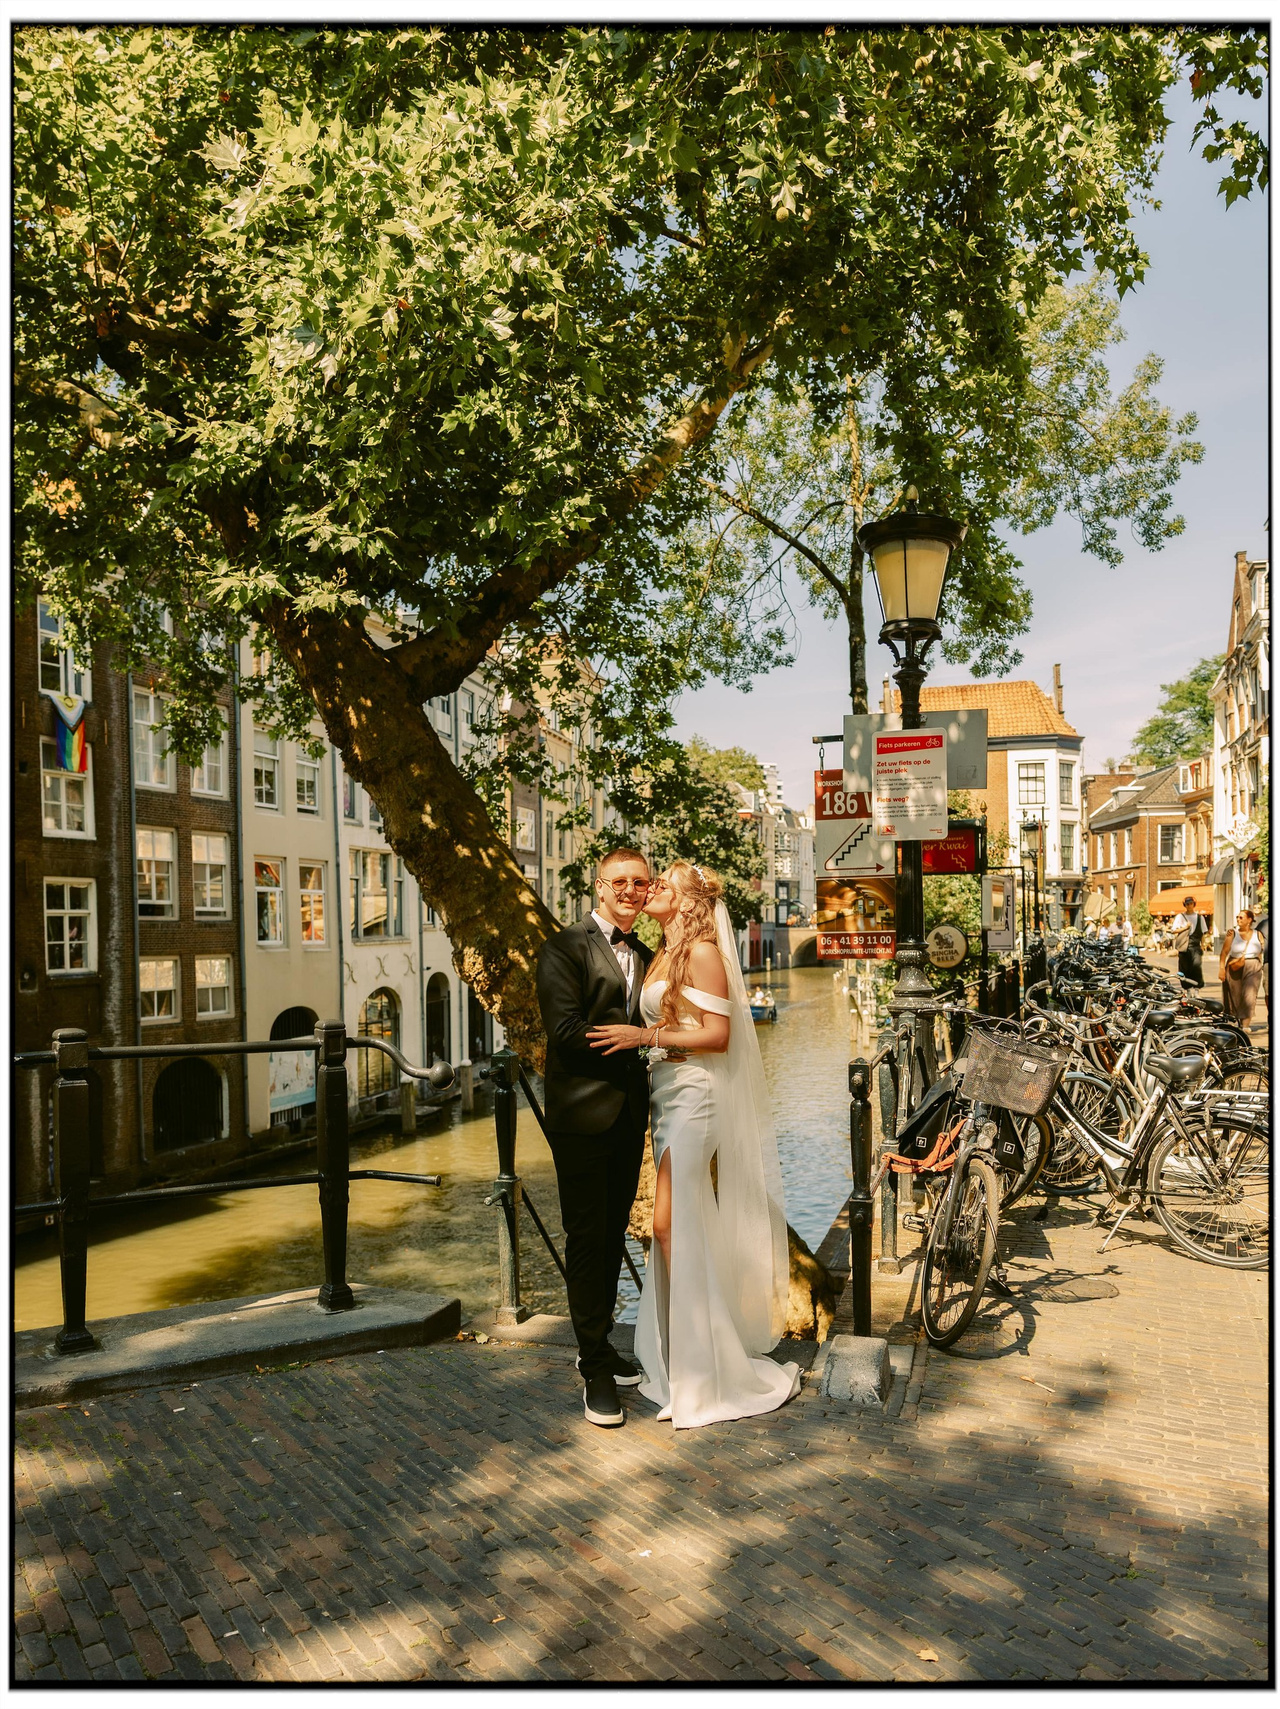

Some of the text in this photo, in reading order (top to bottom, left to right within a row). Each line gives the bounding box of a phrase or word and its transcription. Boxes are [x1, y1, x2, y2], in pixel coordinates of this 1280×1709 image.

[894, 741, 921, 749] parkeren
[822, 791, 858, 816] 186
[938, 841, 969, 851] Kwai
[820, 936, 832, 946] 06
[839, 936, 851, 945] 41
[852, 935, 865, 945] 39
[866, 935, 877, 945] 11
[880, 935, 892, 944] 00
[820, 947, 893, 955] WORKSHOPRUIMTE-UTRECHT.NL
[931, 949, 960, 957] SINGHA
